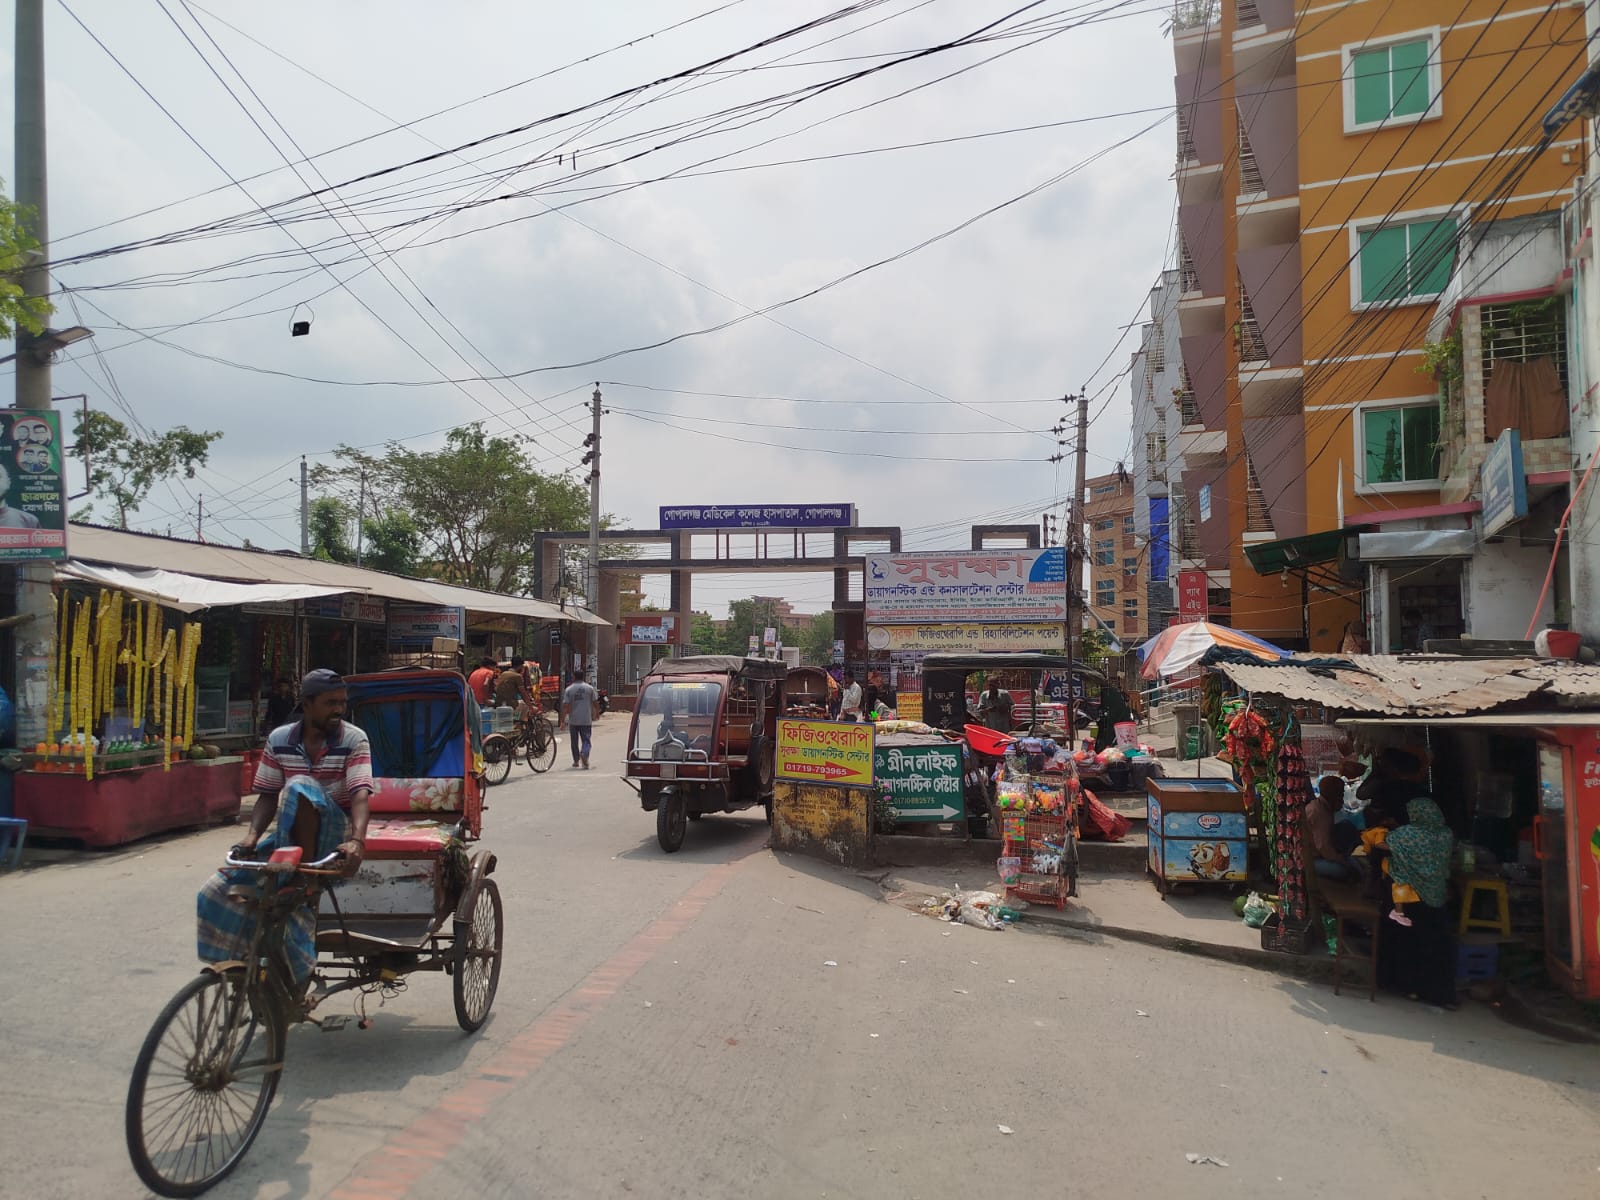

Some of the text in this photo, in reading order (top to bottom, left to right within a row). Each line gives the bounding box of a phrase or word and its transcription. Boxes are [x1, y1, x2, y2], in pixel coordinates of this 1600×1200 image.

[664, 509, 700, 520] গোপালগঞ্জ
[703, 506, 736, 520] মেডিকেল
[738, 508, 760, 519] কলেজ
[890, 556, 1033, 585] সুরক্ষা
[866, 584, 917, 598] ডায়াগনস্টিক
[920, 584, 935, 596] এন্ড
[939, 582, 992, 596] কনসালটেশন
[995, 582, 1024, 596] সেন্টার
[891, 628, 914, 641] সুরক্ষা
[917, 626, 963, 639] ফিজিওথেরাপি
[966, 628, 978, 639] এন্ড
[782, 722, 869, 748] ফিজিওথেরাপি
[780, 746, 870, 762] সুরক্ষা ডায়াগনস্টিক সেন্টার
[888, 749, 957, 772] গ্রীন লাইফ
[786, 764, 847, 775] 01719-793965
[934, 774, 960, 793] সেন্টার
